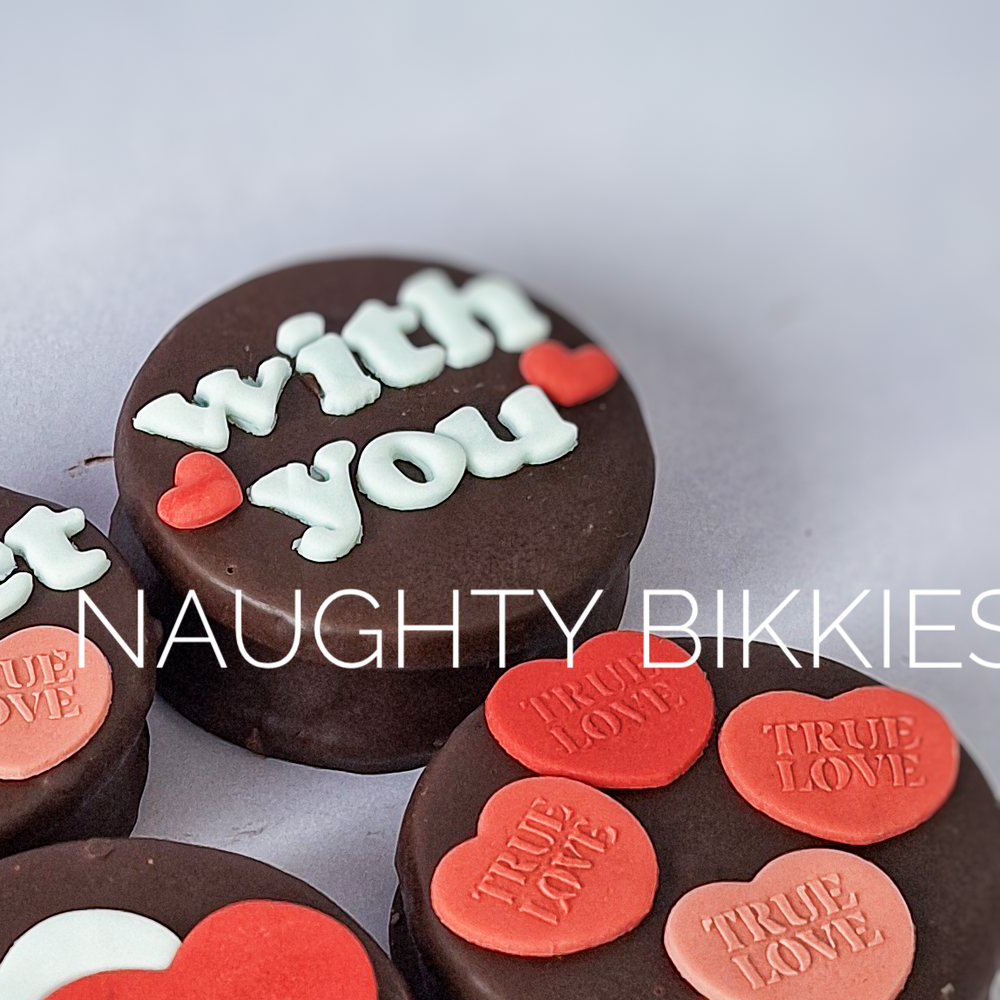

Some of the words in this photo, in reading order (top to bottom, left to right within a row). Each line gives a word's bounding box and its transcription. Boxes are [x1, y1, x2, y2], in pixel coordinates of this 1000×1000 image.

[132, 268, 552, 453] with
[247, 385, 579, 563] you
[519, 648, 662, 726] TRUE
[547, 677, 687, 756] LOVE
[763, 715, 923, 757] TRUE
[776, 752, 928, 794] LOVE
[471, 797, 573, 908] TRUE
[518, 817, 619, 925] LOVE
[701, 872, 861, 953] TRUE
[731, 910, 885, 990] LOVE
